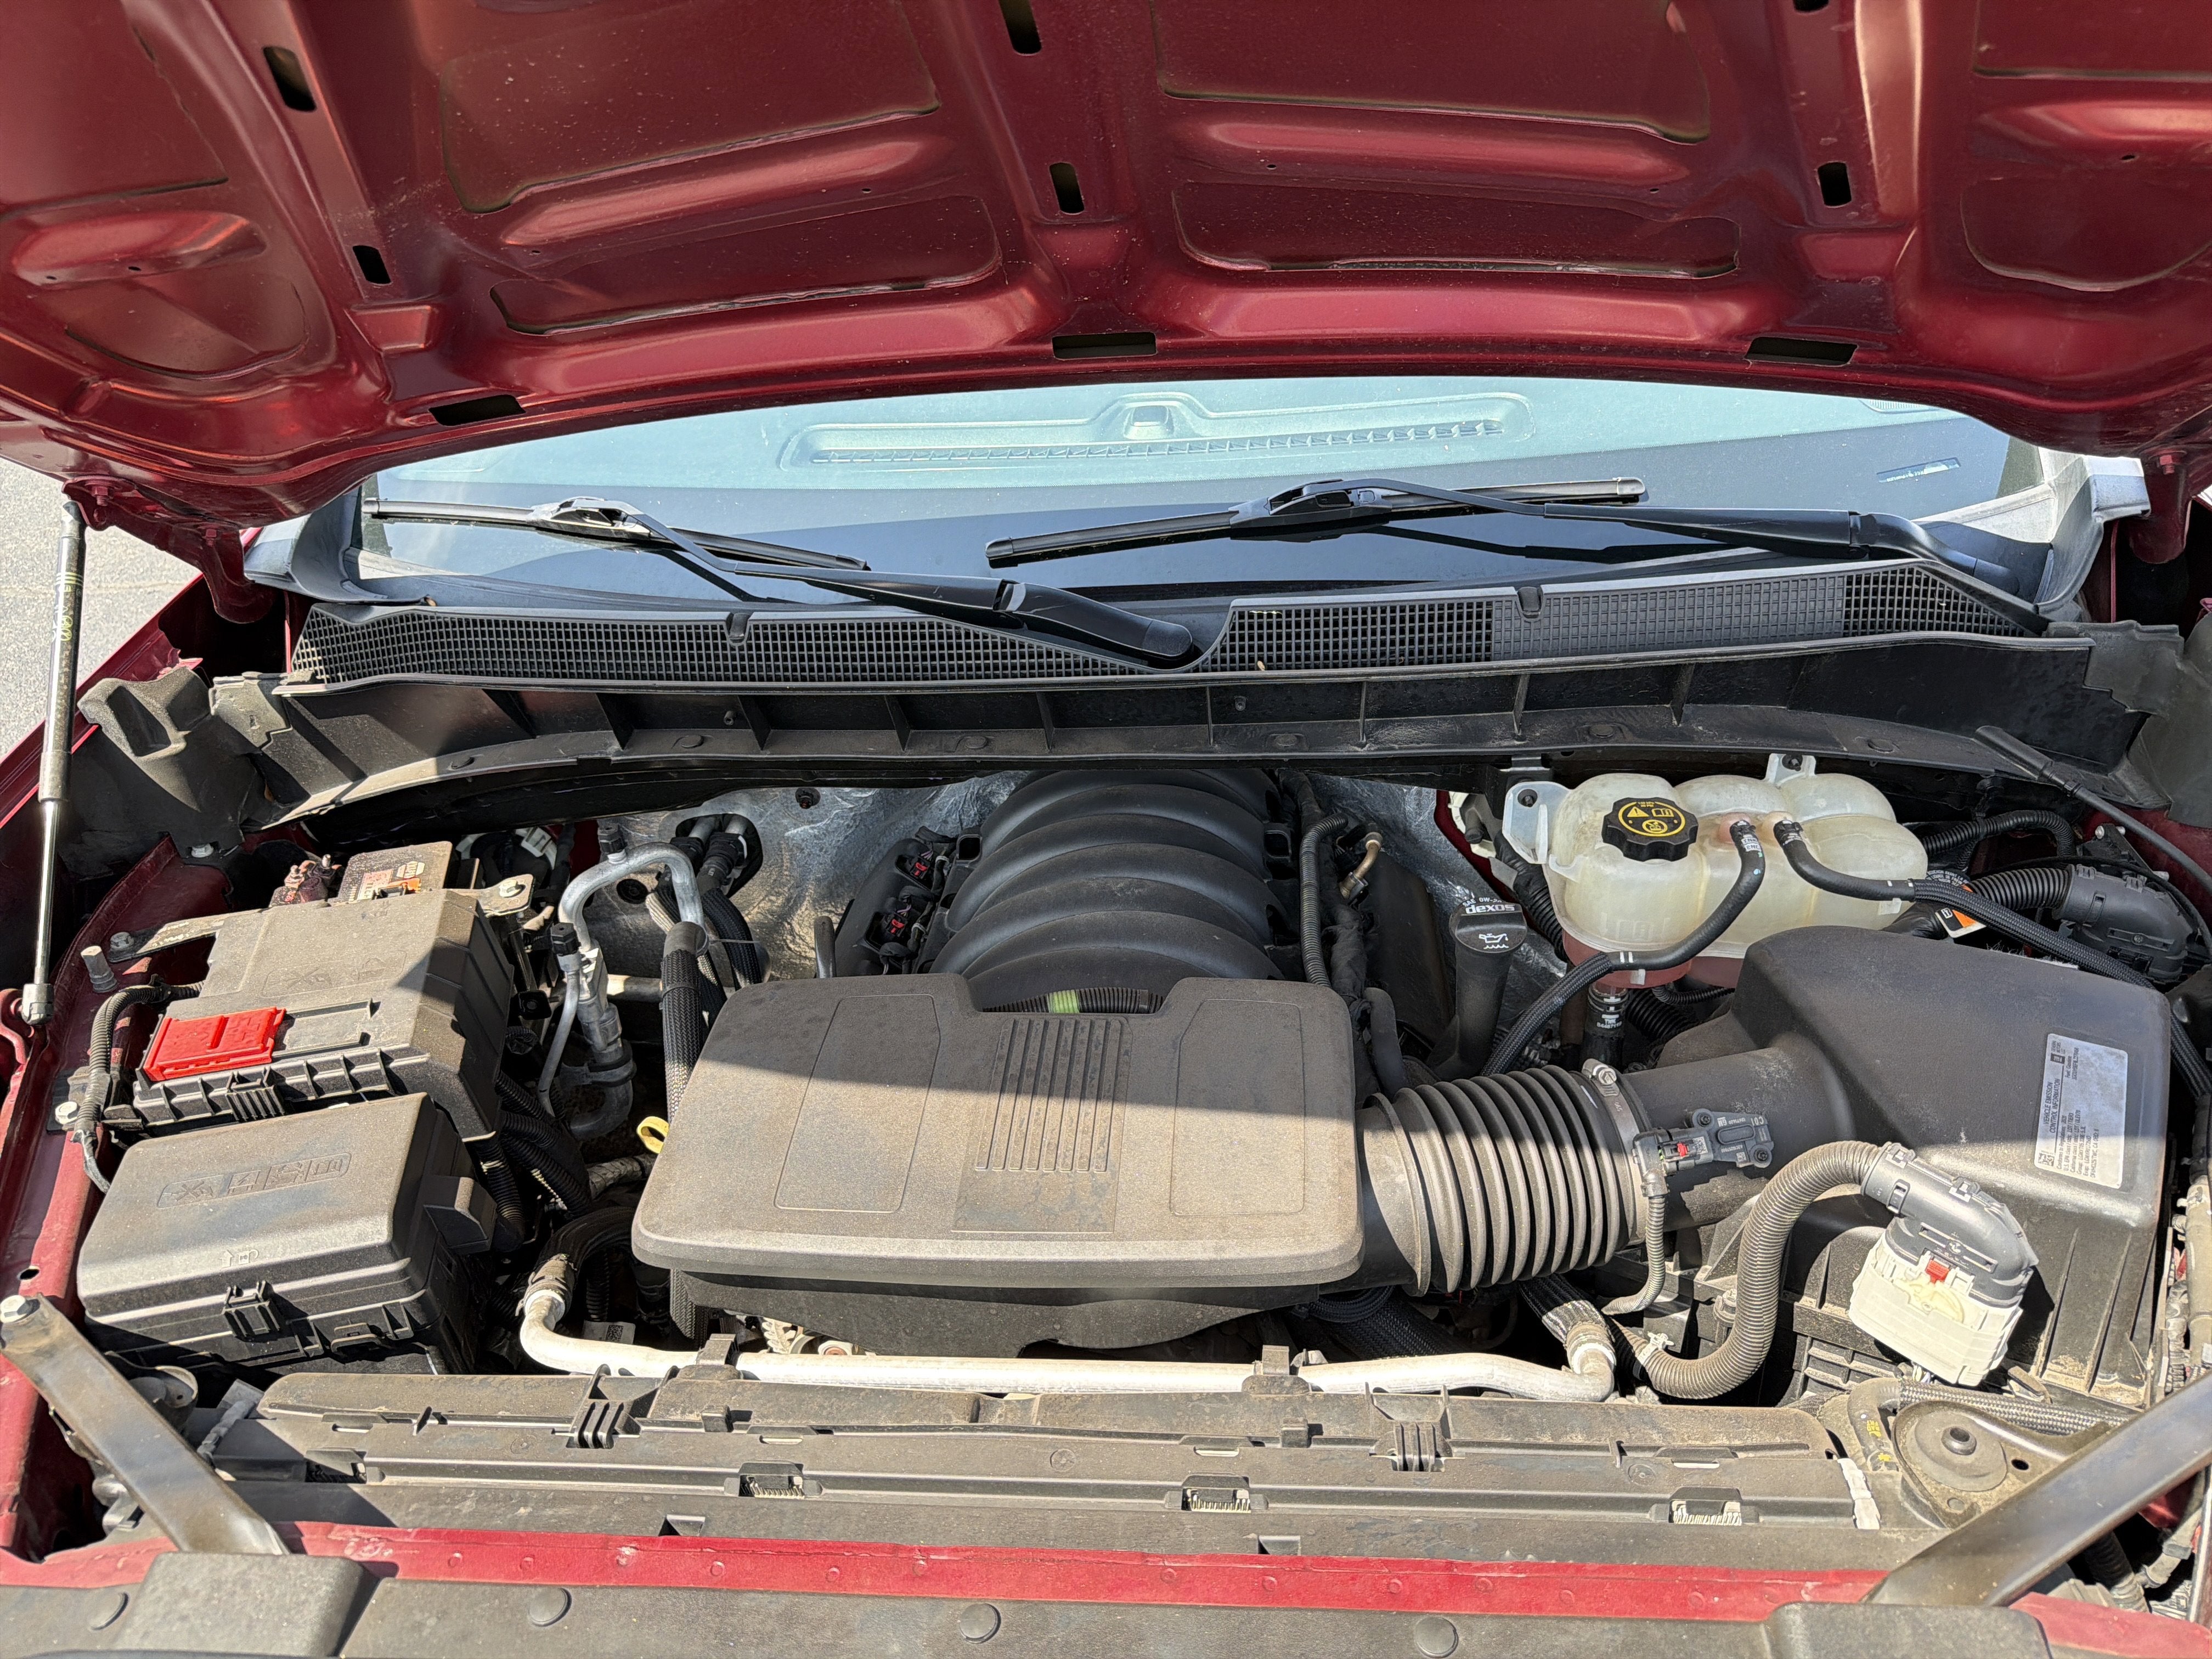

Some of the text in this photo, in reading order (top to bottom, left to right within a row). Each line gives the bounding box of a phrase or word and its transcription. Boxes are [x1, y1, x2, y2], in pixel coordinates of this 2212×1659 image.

[1462, 898, 1476, 907] SAE
[1465, 904, 1515, 914] dexos
[2049, 1077, 2060, 1133] CONTROL INFORMATION
[1717, 1118, 1727, 1127] GM
[1750, 1116, 1764, 1126] C01
